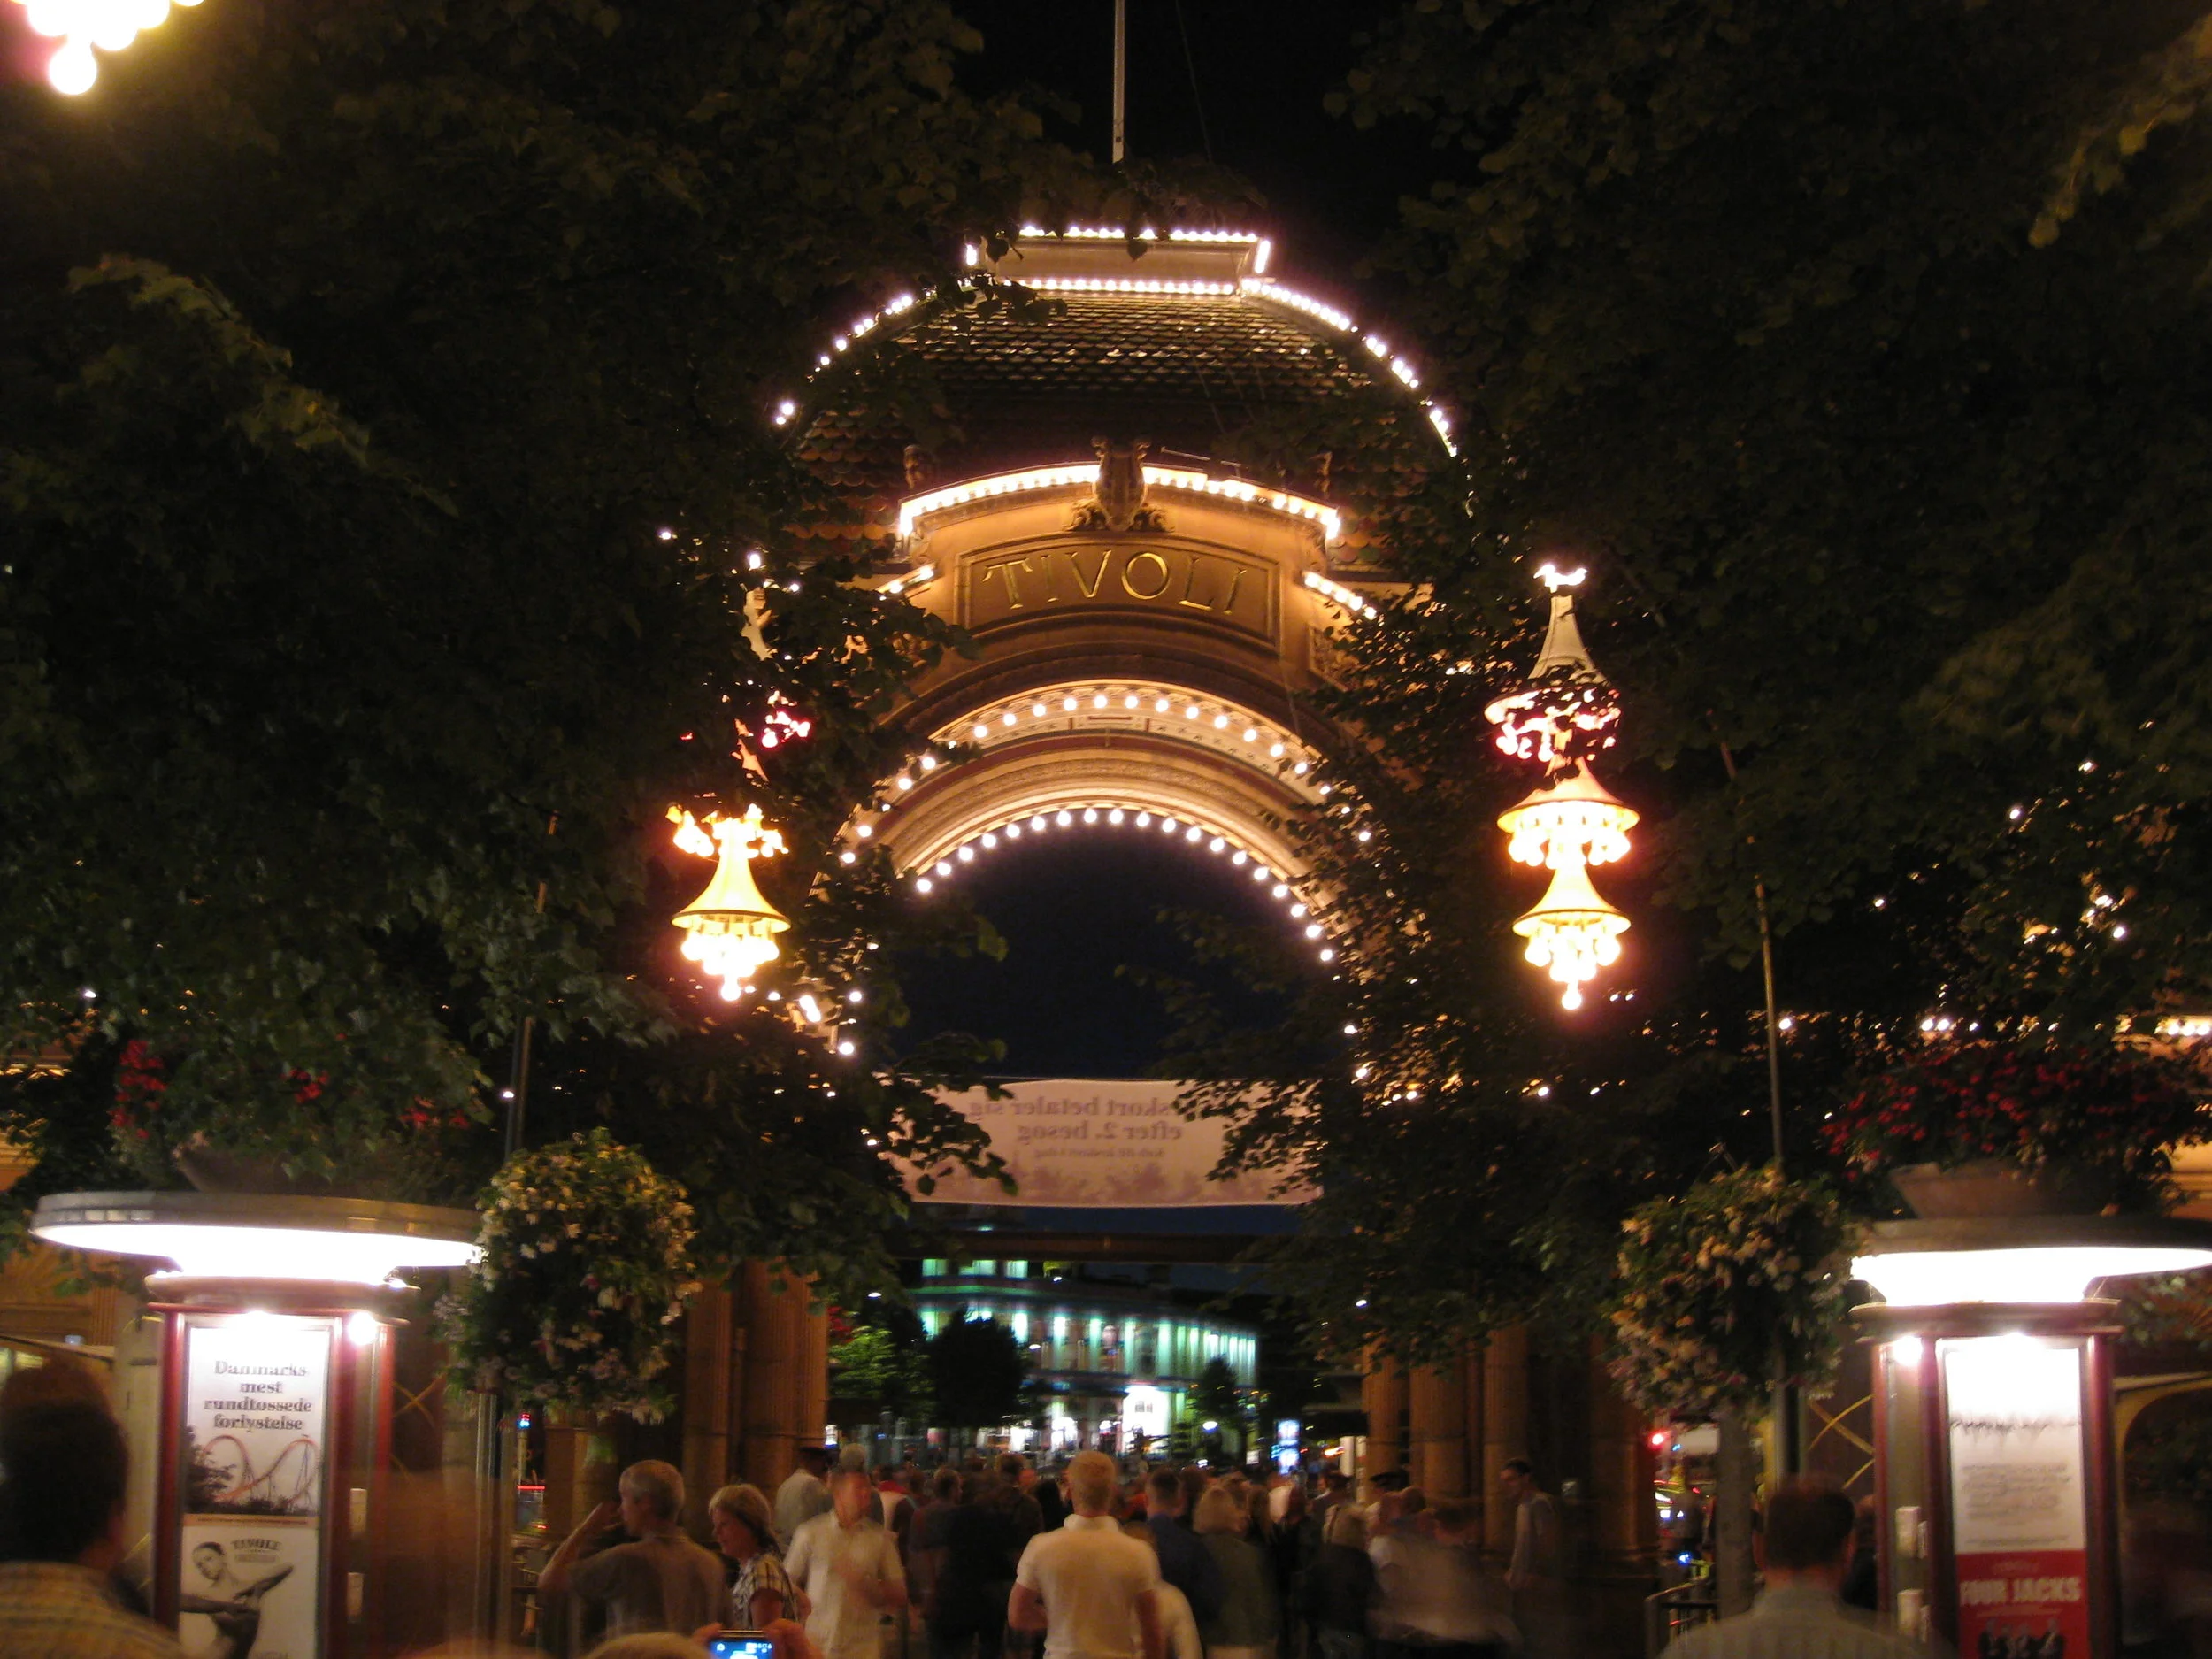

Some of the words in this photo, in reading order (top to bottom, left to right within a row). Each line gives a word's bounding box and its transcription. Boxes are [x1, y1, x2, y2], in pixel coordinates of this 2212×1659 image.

[981, 549, 1247, 614] TIVOLI
[212, 1360, 308, 1377] Danmarks
[239, 1380, 284, 1394] mest
[203, 1394, 312, 1412] rundtossede
[213, 1413, 303, 1433] forlystelse
[2012, 1576, 2081, 1603] JACKS
